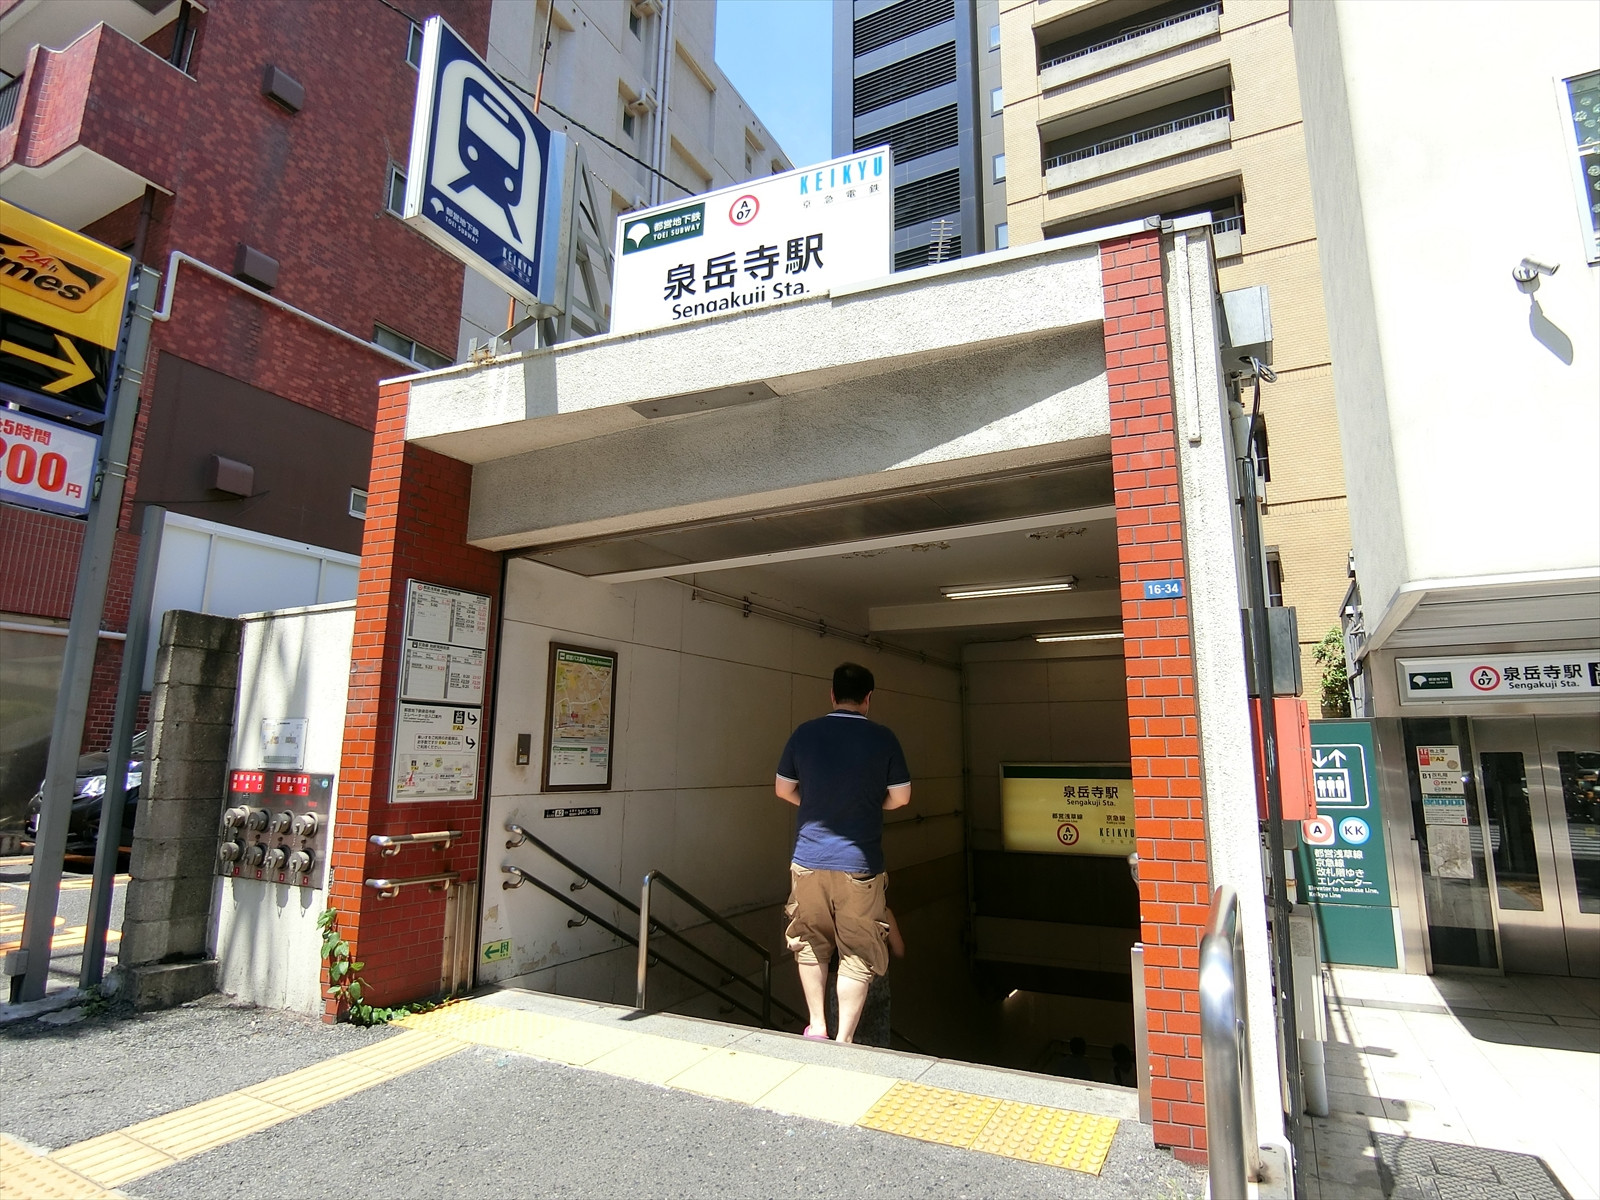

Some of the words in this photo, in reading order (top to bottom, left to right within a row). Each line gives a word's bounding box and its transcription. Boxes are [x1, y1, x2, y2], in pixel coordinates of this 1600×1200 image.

[800, 156, 883, 195] KEIKYU
[741, 200, 749, 210] A
[736, 209, 752, 220] 07
[654, 212, 702, 232] 都営地下鉄
[653, 231, 669, 240] TOEI
[671, 222, 701, 236] SUBWAY
[502, 246, 532, 277] KEIKYU
[663, 233, 823, 301] 泉岳寺駅
[773, 282, 811, 300] Sta.
[0, 416, 51, 446] 5時間
[0, 435, 82, 498] 00円
[1147, 583, 1179, 595] 16-34
[1503, 664, 1583, 681] 泉岳寺駅
[1478, 677, 1492, 686] 07
[1508, 680, 1557, 691] Sengakuji
[1561, 680, 1580, 688] Sta.
[1064, 785, 1119, 799] 泉岳寺駅
[1066, 799, 1101, 807] Sengakuji
[1099, 827, 1134, 838] KEIKYU
[1313, 825, 1322, 834] A
[1062, 833, 1073, 841] 07
[1314, 848, 1364, 859] 都営浅草線
[1315, 858, 1345, 867] 京急線
[1316, 867, 1365, 877] 改札階ゆき
[1317, 877, 1372, 887] エレベーター
